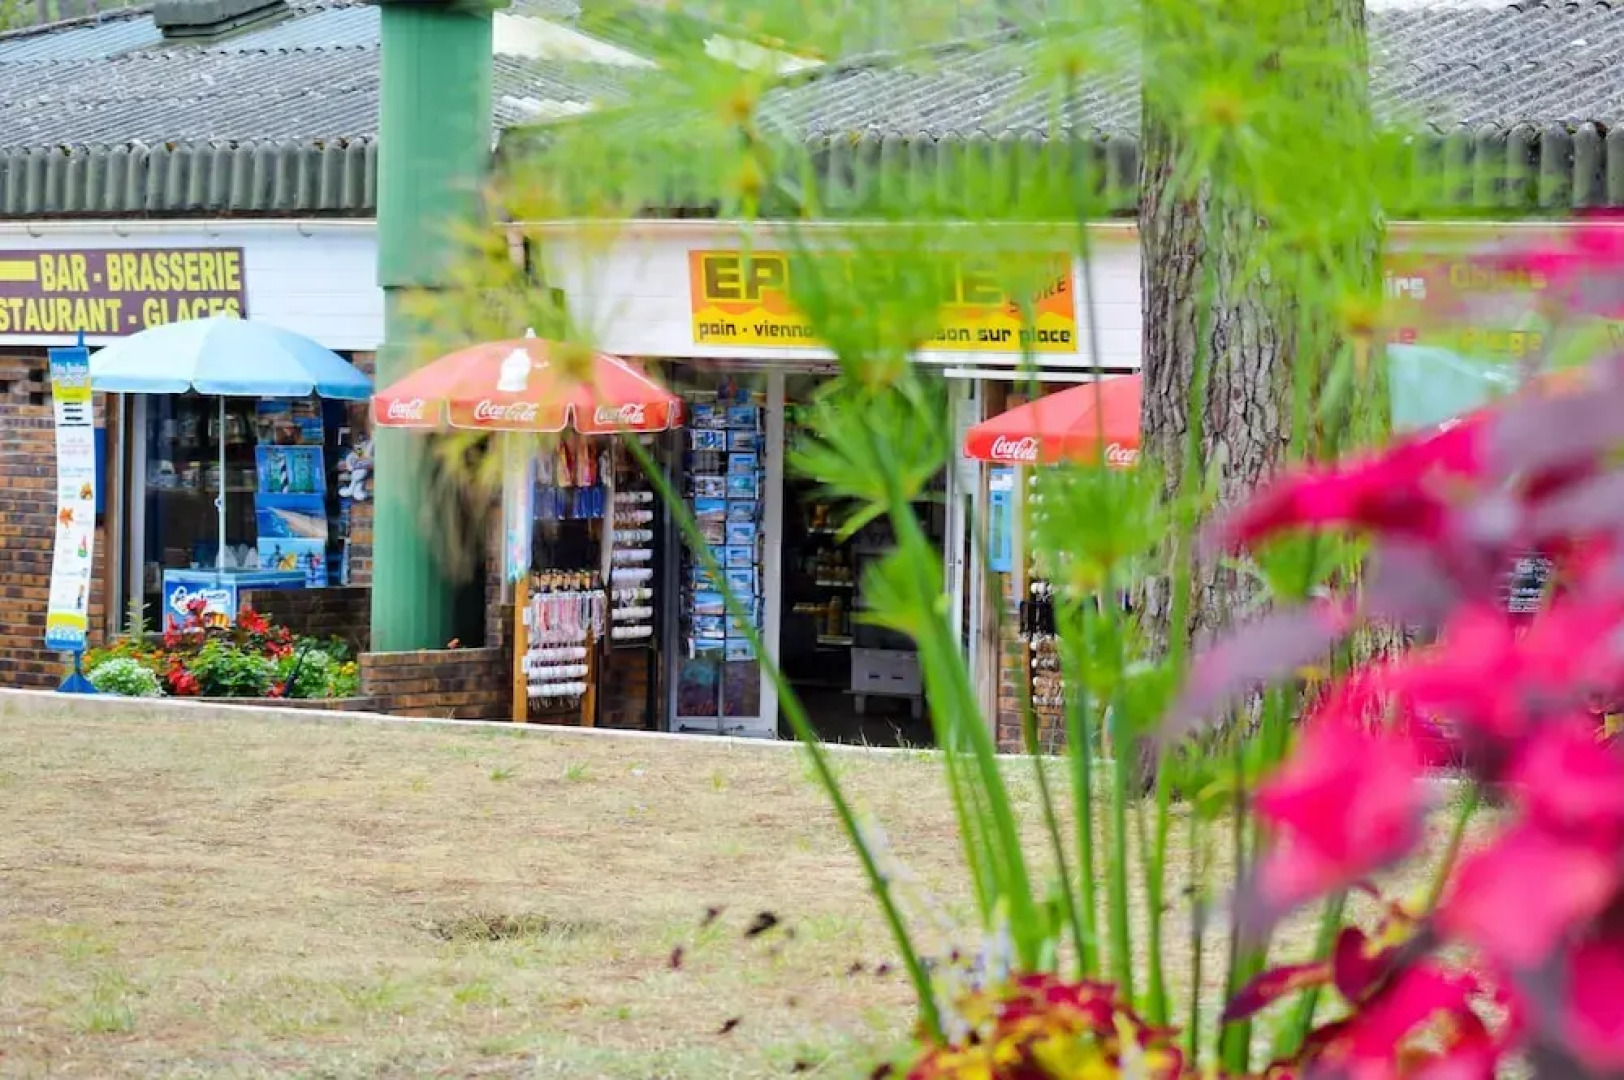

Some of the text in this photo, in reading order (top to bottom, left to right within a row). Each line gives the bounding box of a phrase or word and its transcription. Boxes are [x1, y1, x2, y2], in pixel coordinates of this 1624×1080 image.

[39, 251, 242, 292] BAR BRASSERIE
[0, 298, 121, 332] STAURANT
[699, 320, 736, 339] pain
[978, 328, 1012, 342] sur
[474, 399, 539, 422] Coca-Cola
[594, 403, 645, 425] Coca-Cola
[990, 434, 1039, 461] Coca-Cola
